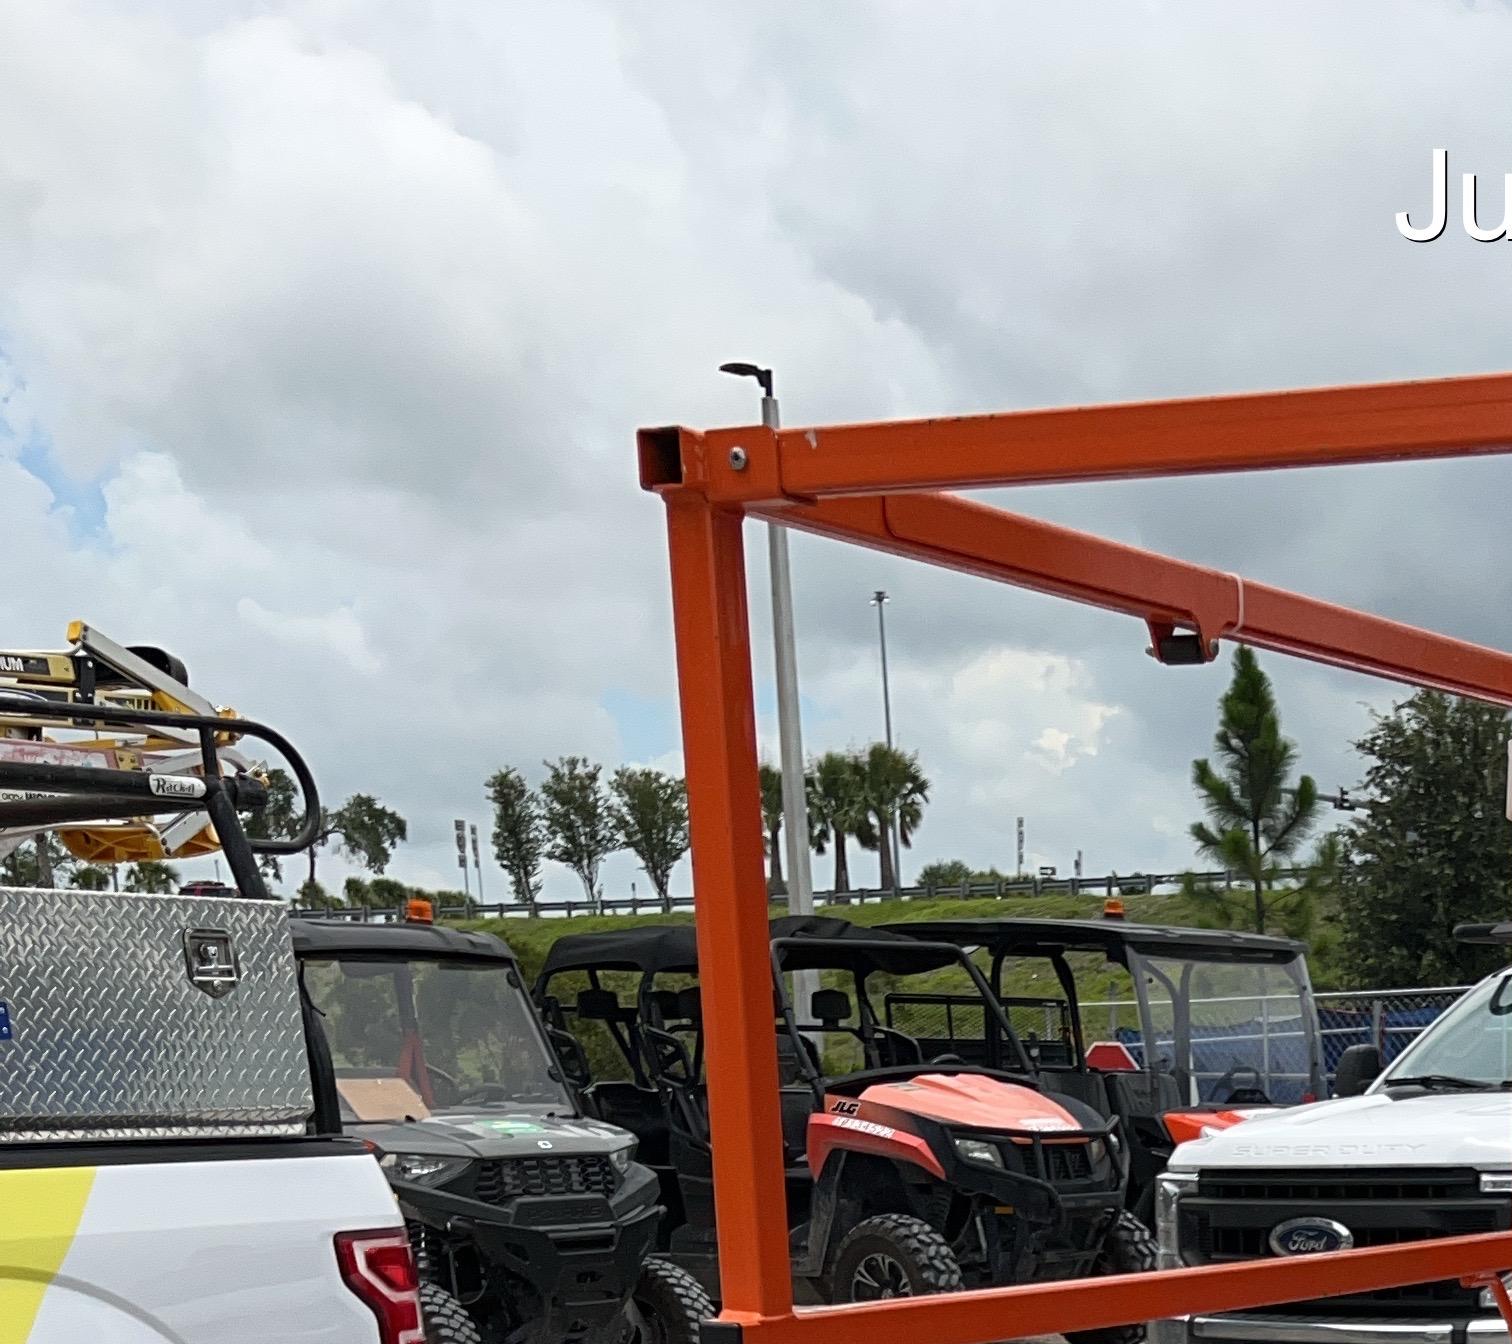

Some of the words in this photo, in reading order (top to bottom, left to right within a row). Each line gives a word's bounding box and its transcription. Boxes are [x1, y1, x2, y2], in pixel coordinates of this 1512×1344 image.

[831, 1100, 859, 1115] JLG
[1232, 1144, 1329, 1156] SUPER
[1339, 1143, 1426, 1155] DUTY
[1288, 1229, 1328, 1251] Ford
